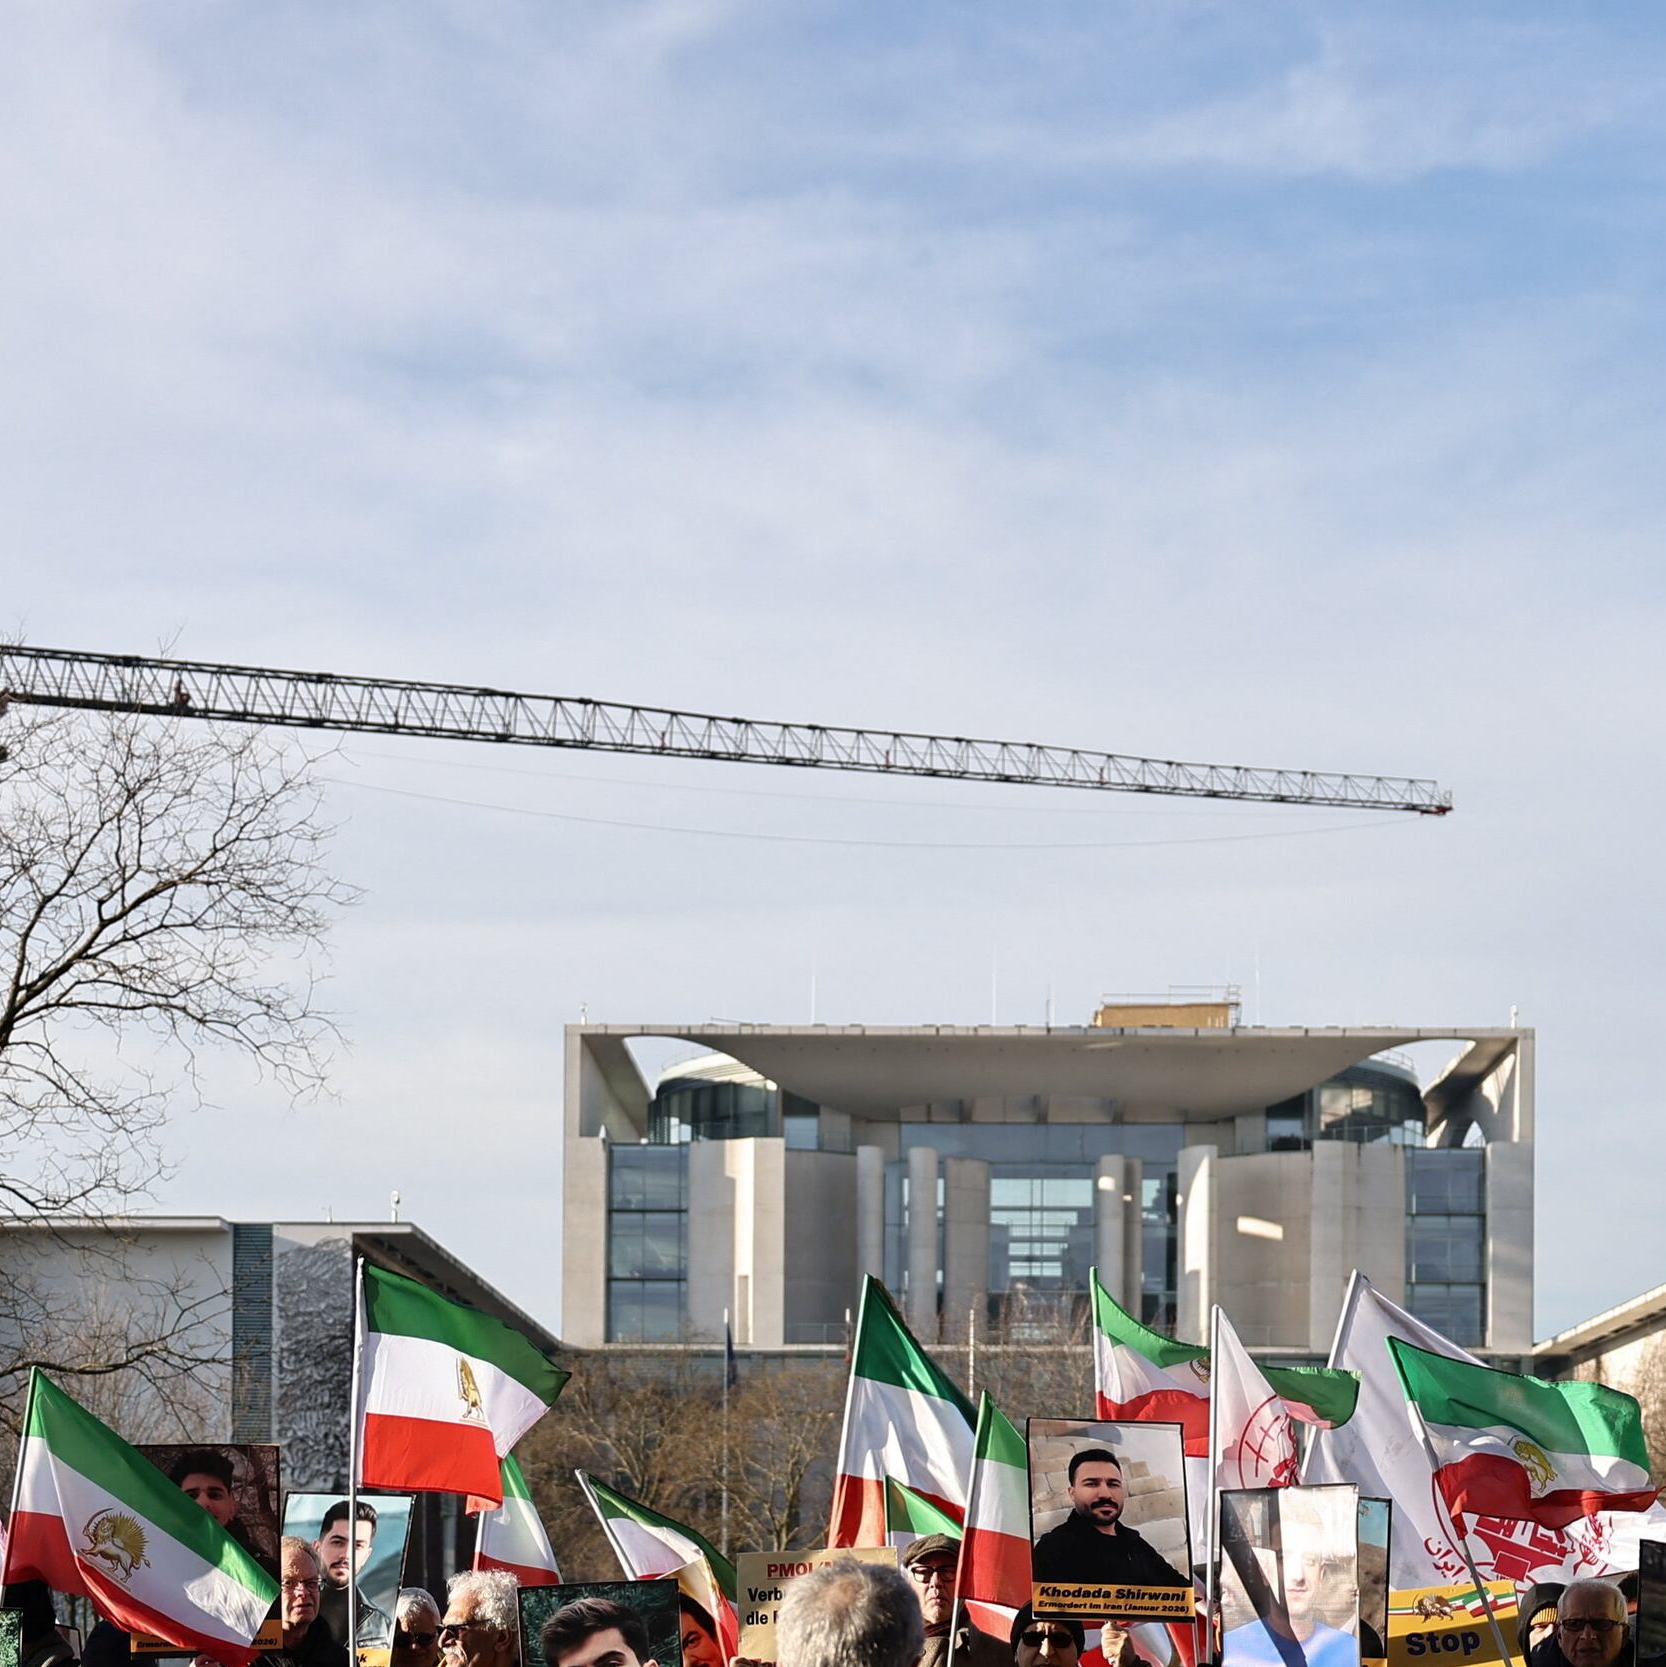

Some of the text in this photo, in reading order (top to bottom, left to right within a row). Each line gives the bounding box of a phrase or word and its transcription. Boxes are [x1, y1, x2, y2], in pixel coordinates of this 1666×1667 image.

[1040, 1586, 1186, 1602] Khodada Shirwani
[1038, 1601, 1087, 1609] Ermordert
[1124, 1604, 1160, 1612] (Januar
[1161, 1605, 1189, 1613] 2026)
[746, 1611, 768, 1625] die
[1405, 1630, 1480, 1657] Stop
